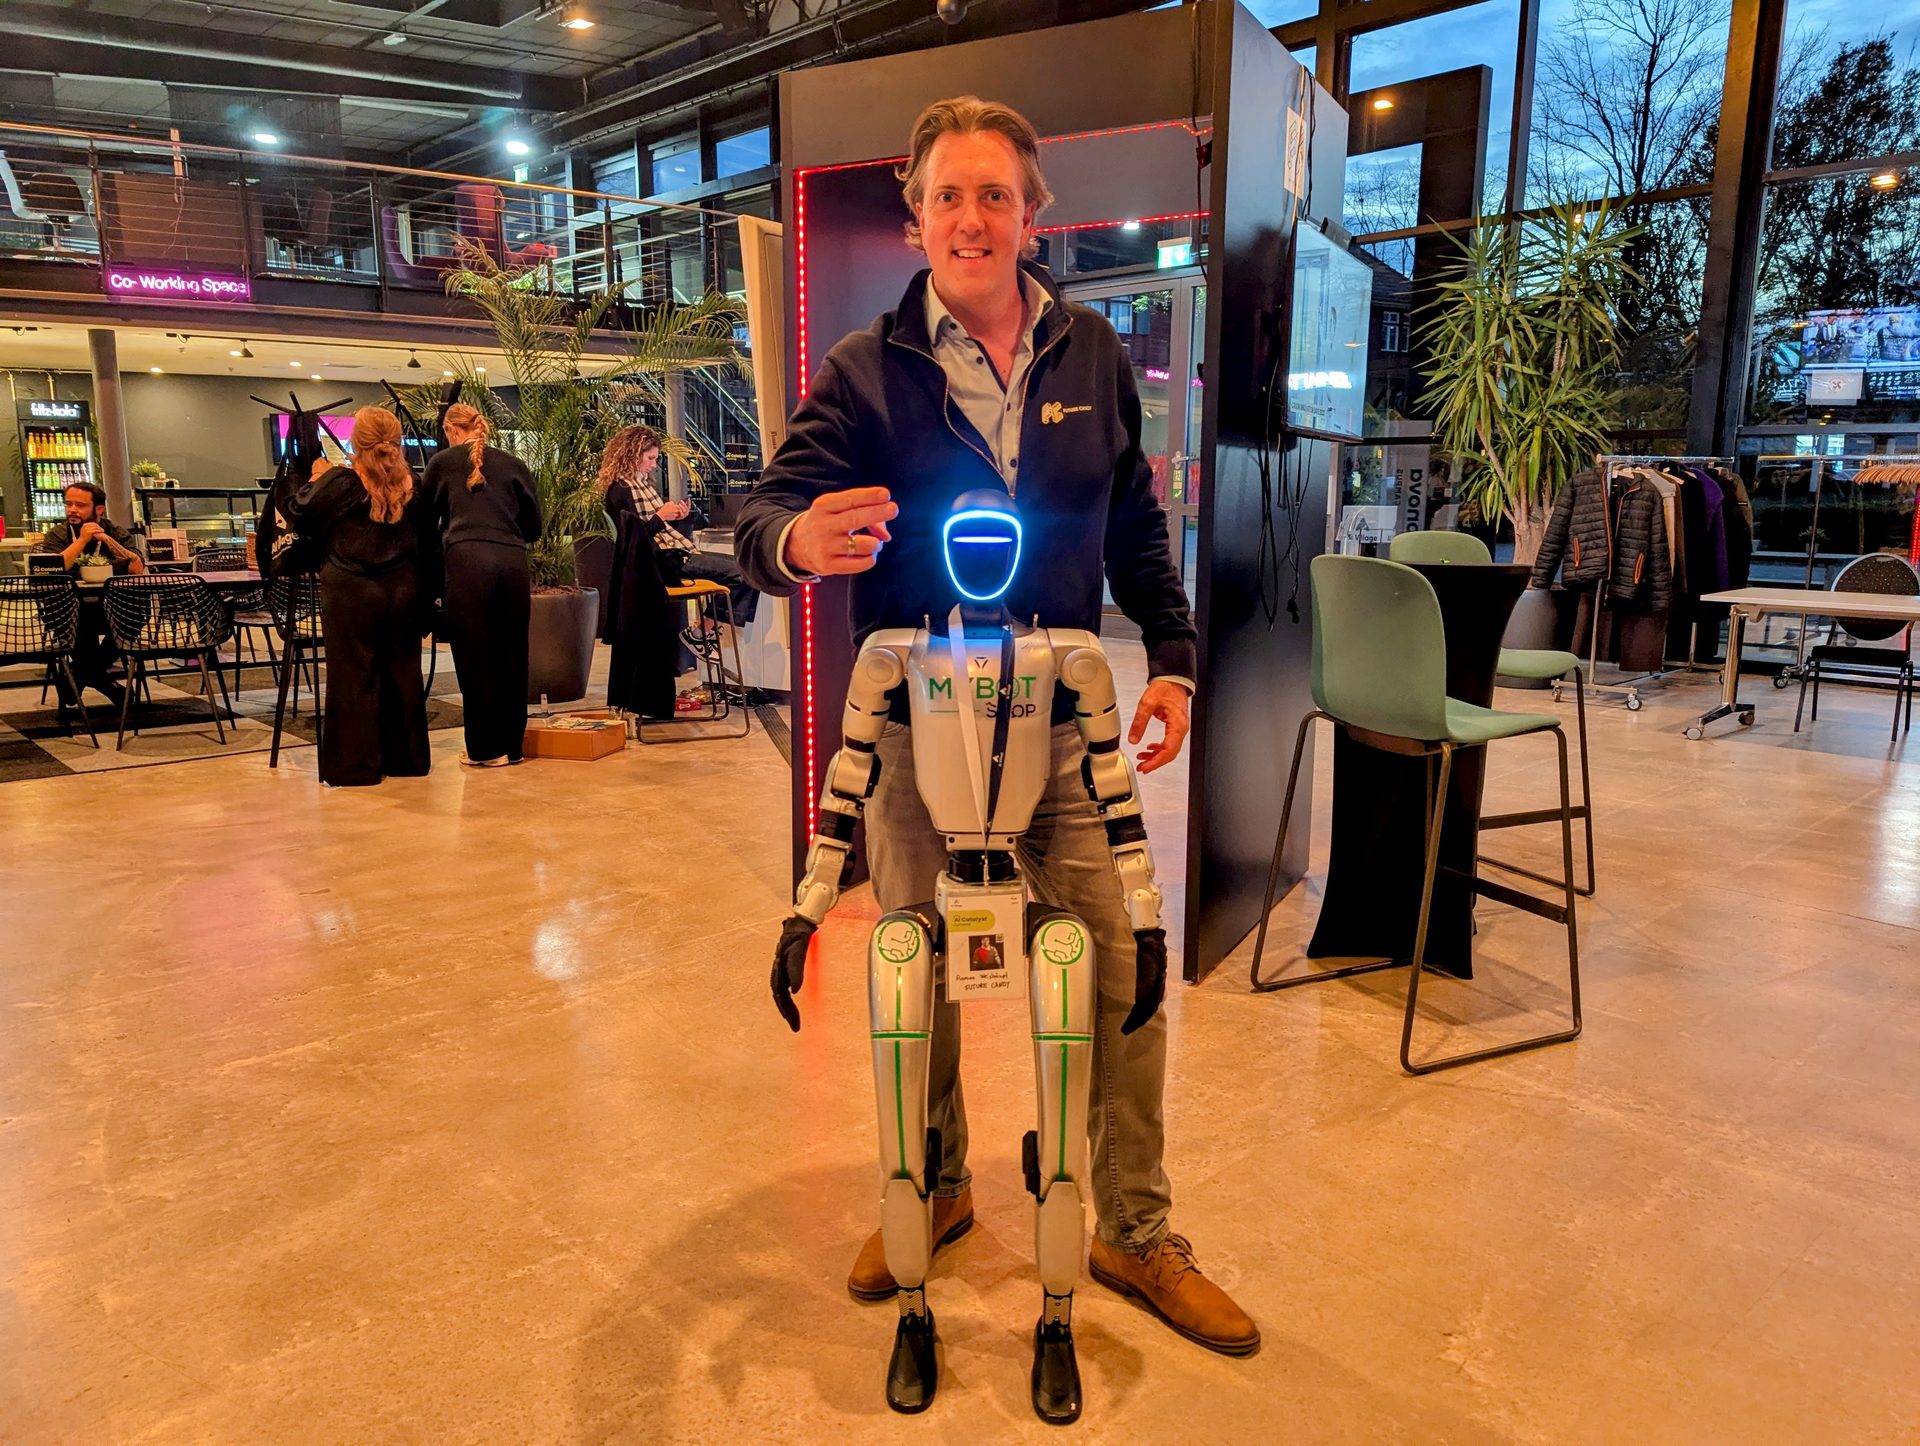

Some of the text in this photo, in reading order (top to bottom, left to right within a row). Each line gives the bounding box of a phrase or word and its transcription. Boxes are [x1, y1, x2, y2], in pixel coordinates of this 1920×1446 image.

[139, 275, 200, 293] Working
[202, 278, 247, 293] Space
[929, 676, 1037, 700] MBOT
[986, 703, 1036, 718] SOP
